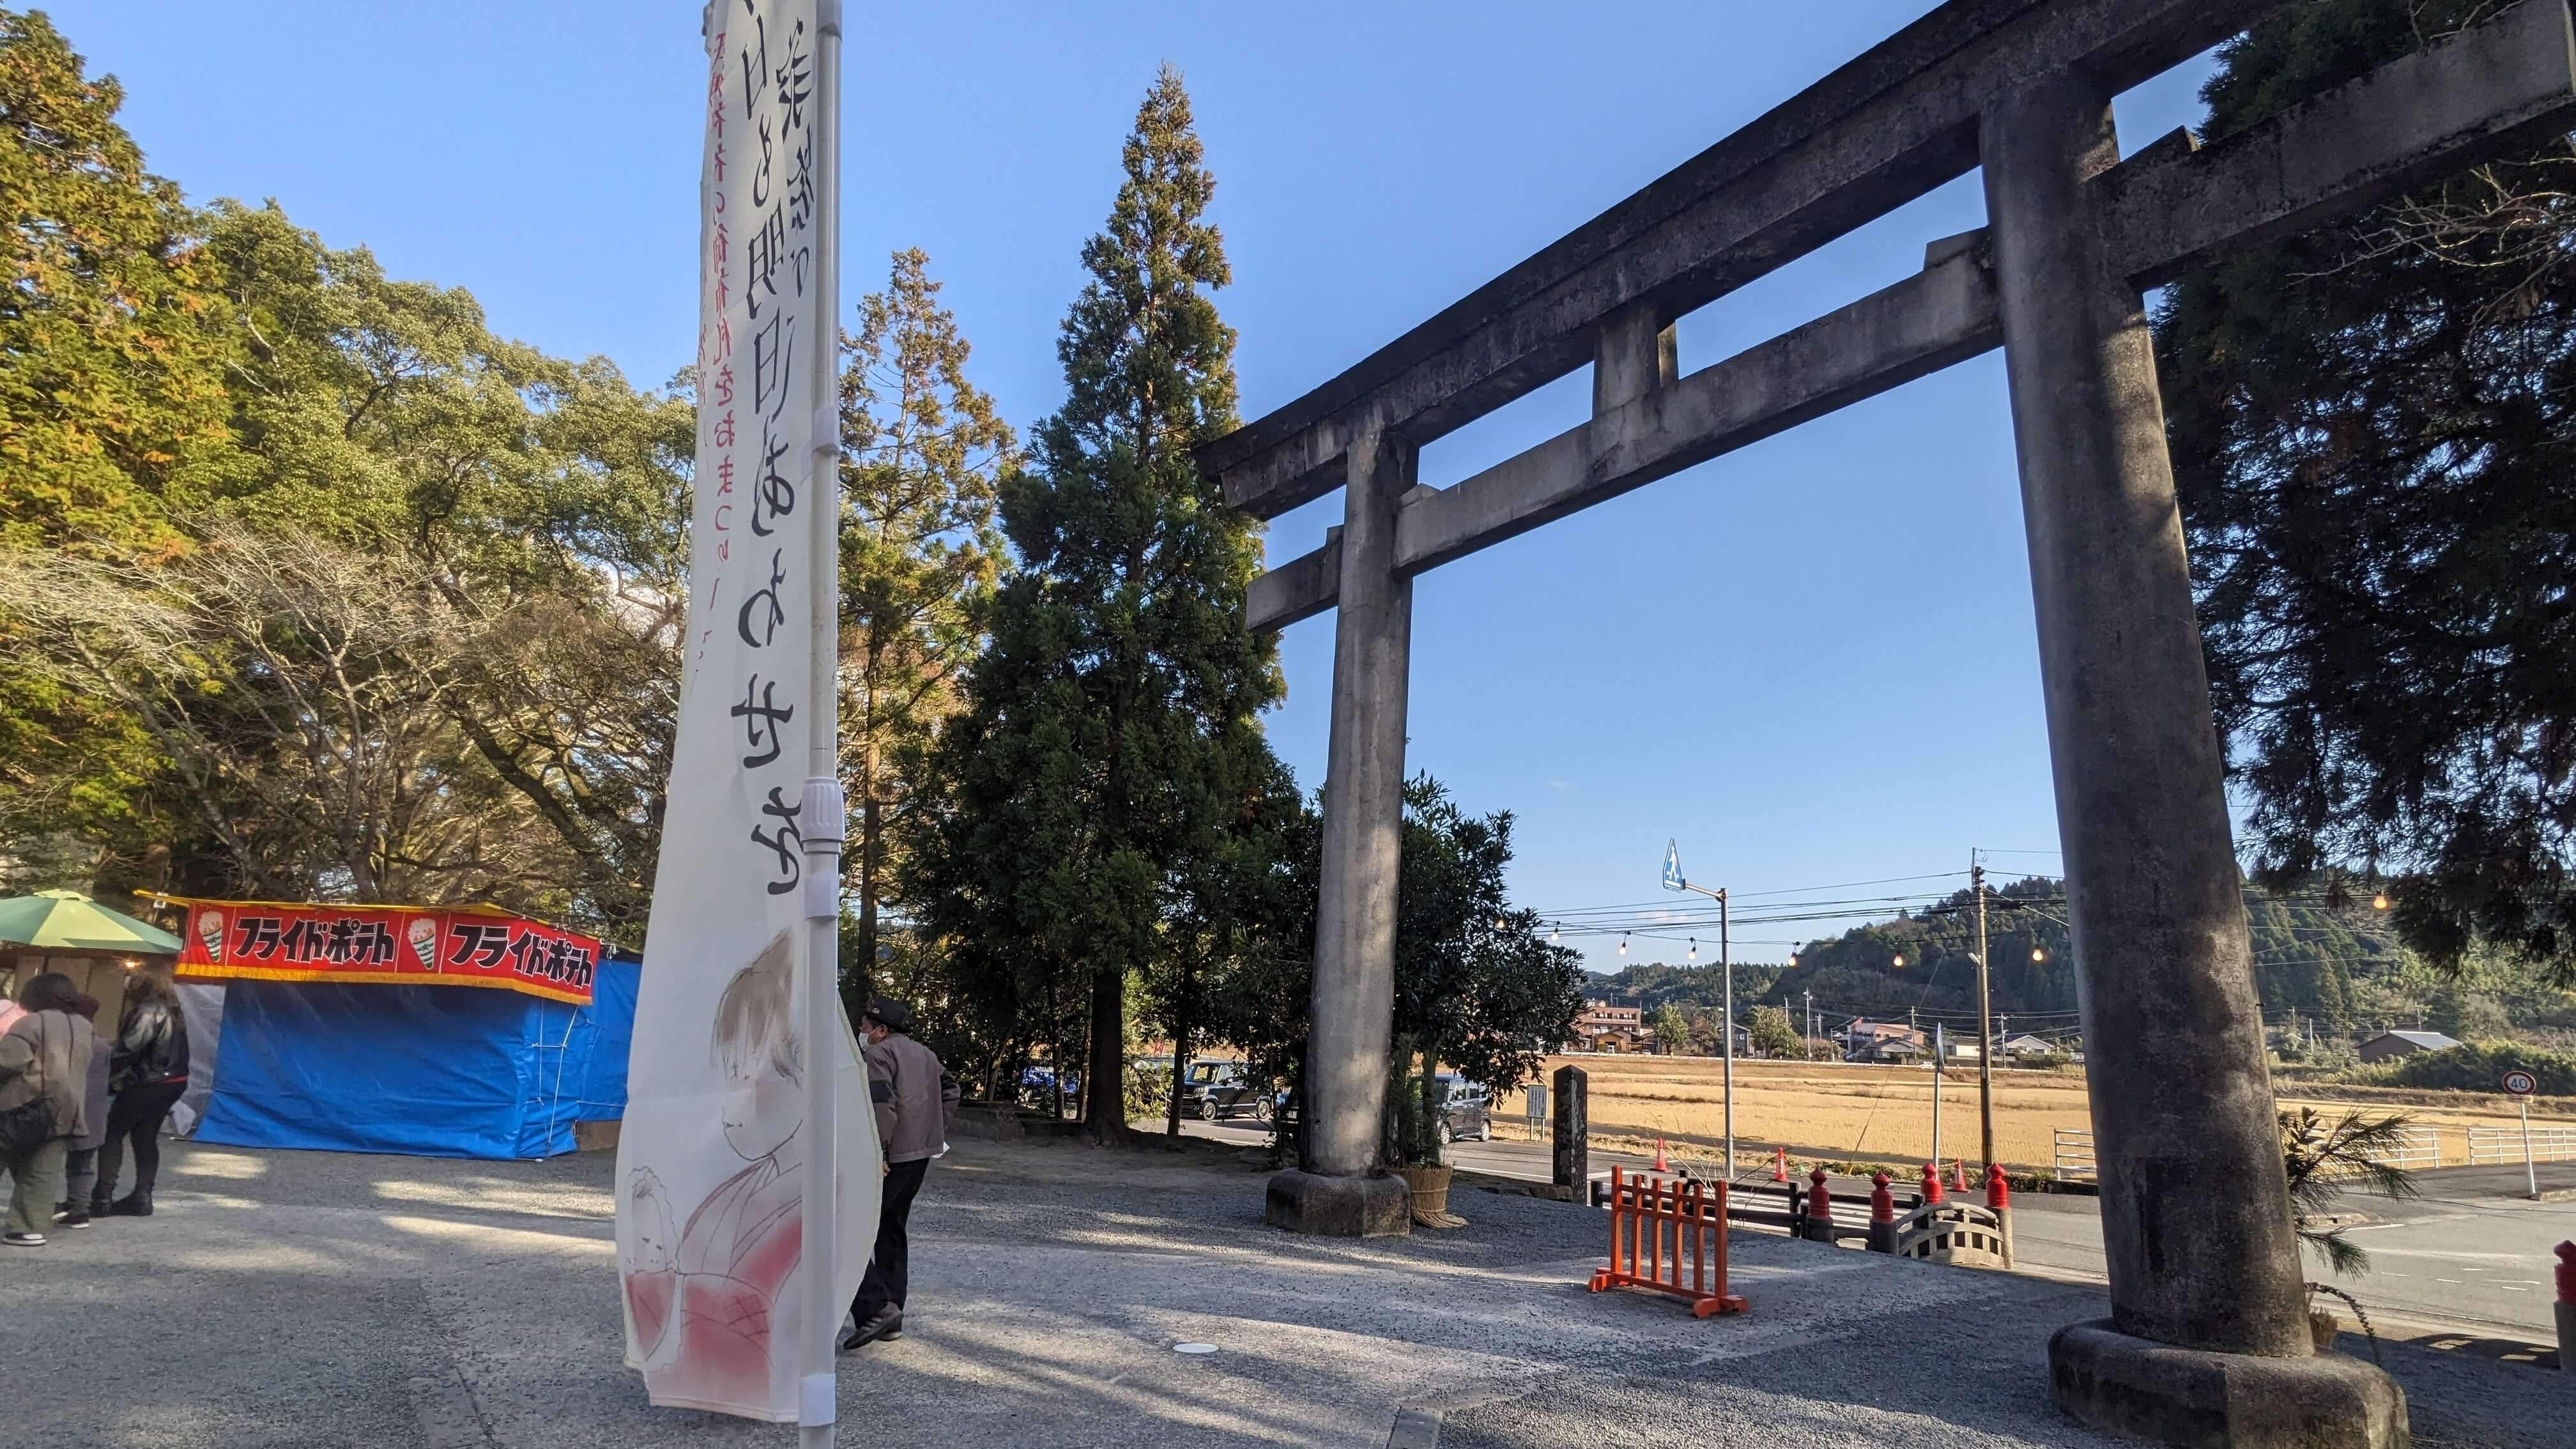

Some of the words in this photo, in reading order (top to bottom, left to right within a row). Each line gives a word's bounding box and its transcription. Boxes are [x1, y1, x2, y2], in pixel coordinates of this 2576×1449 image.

[233, 916, 396, 966] フライドポテト
[448, 923, 594, 989] フライドポテト
[2510, 1078, 2528, 1089] 40
